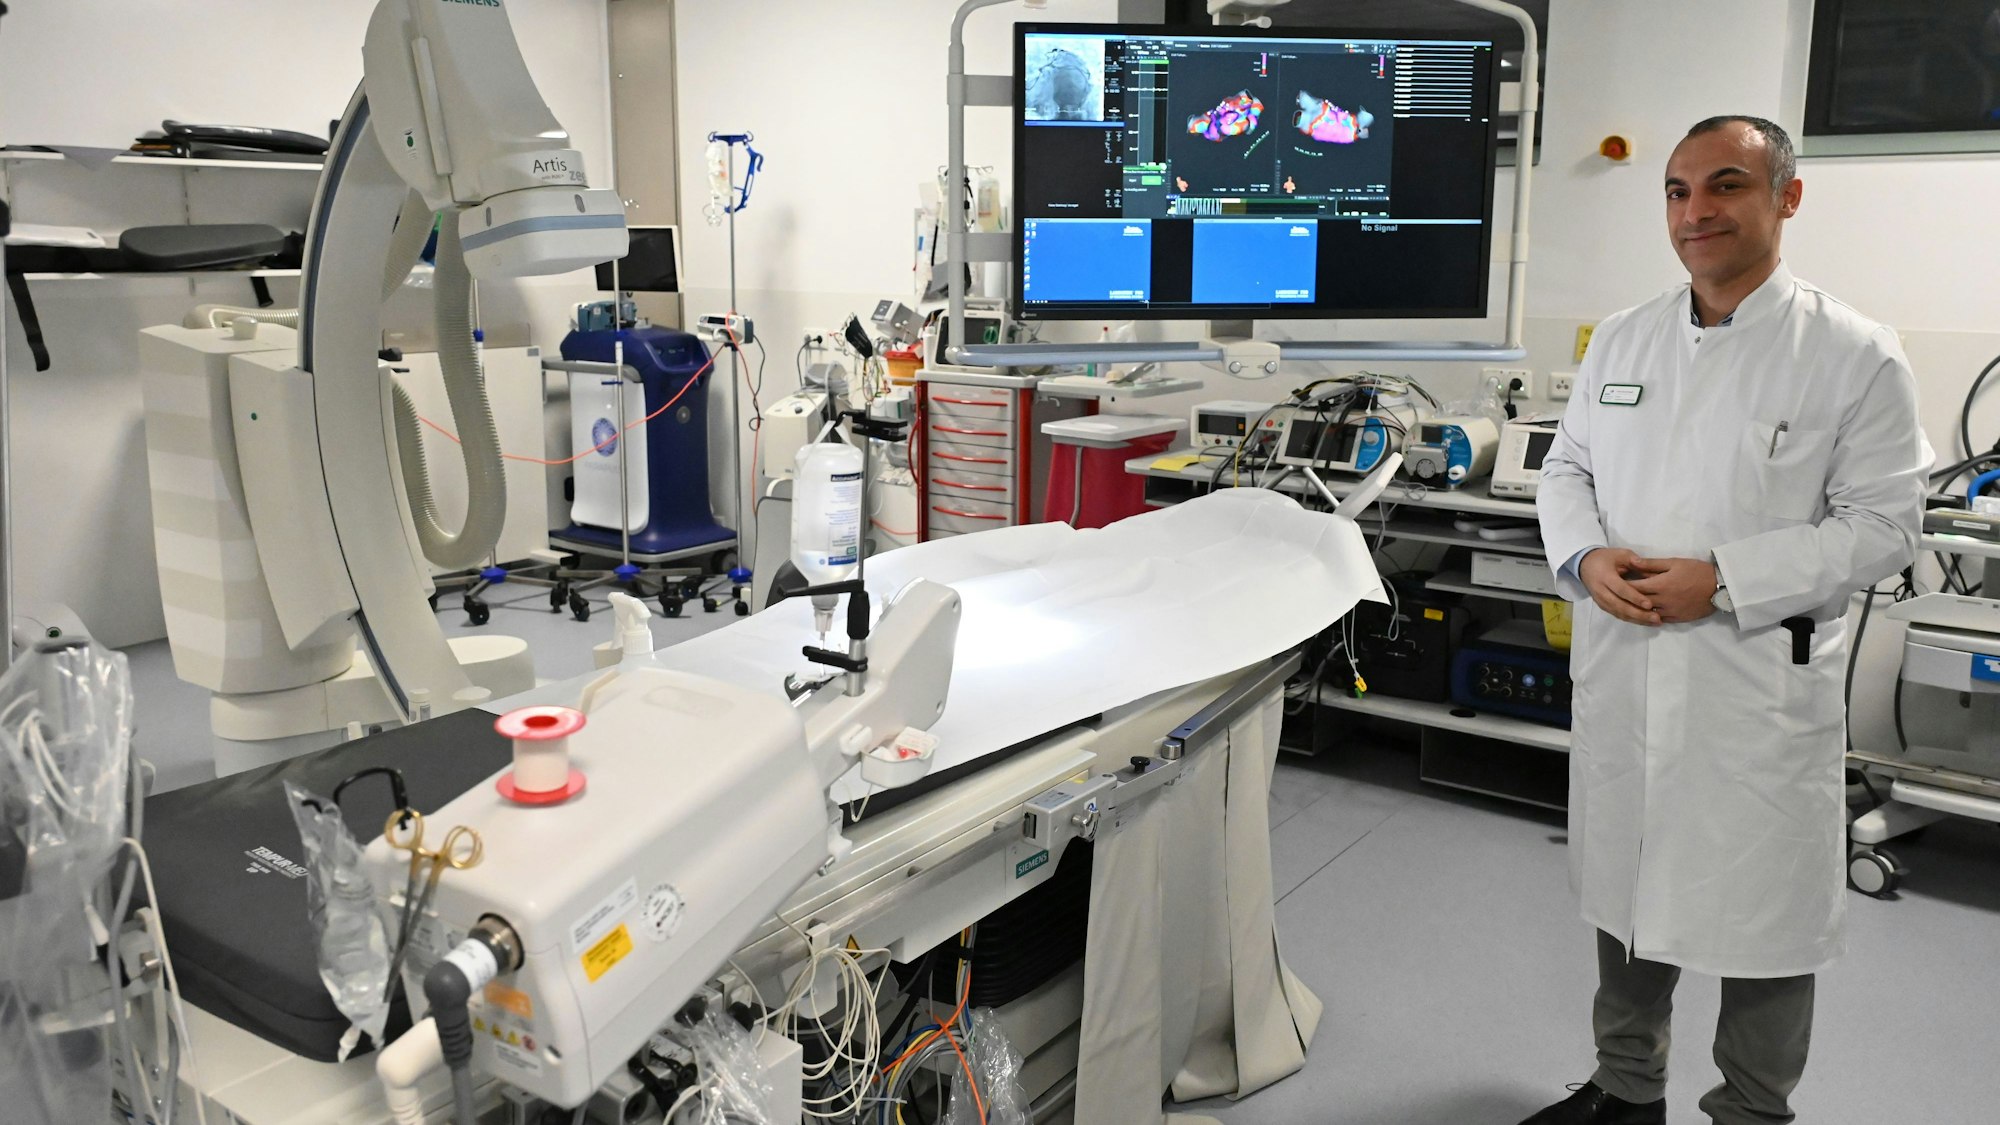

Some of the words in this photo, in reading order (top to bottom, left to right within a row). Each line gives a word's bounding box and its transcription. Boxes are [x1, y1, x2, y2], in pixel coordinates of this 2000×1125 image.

[533, 156, 567, 174] Artis
[1361, 224, 1372, 232] No
[1374, 224, 1398, 233] Signal
[1018, 852, 1048, 875] SIEMENS
